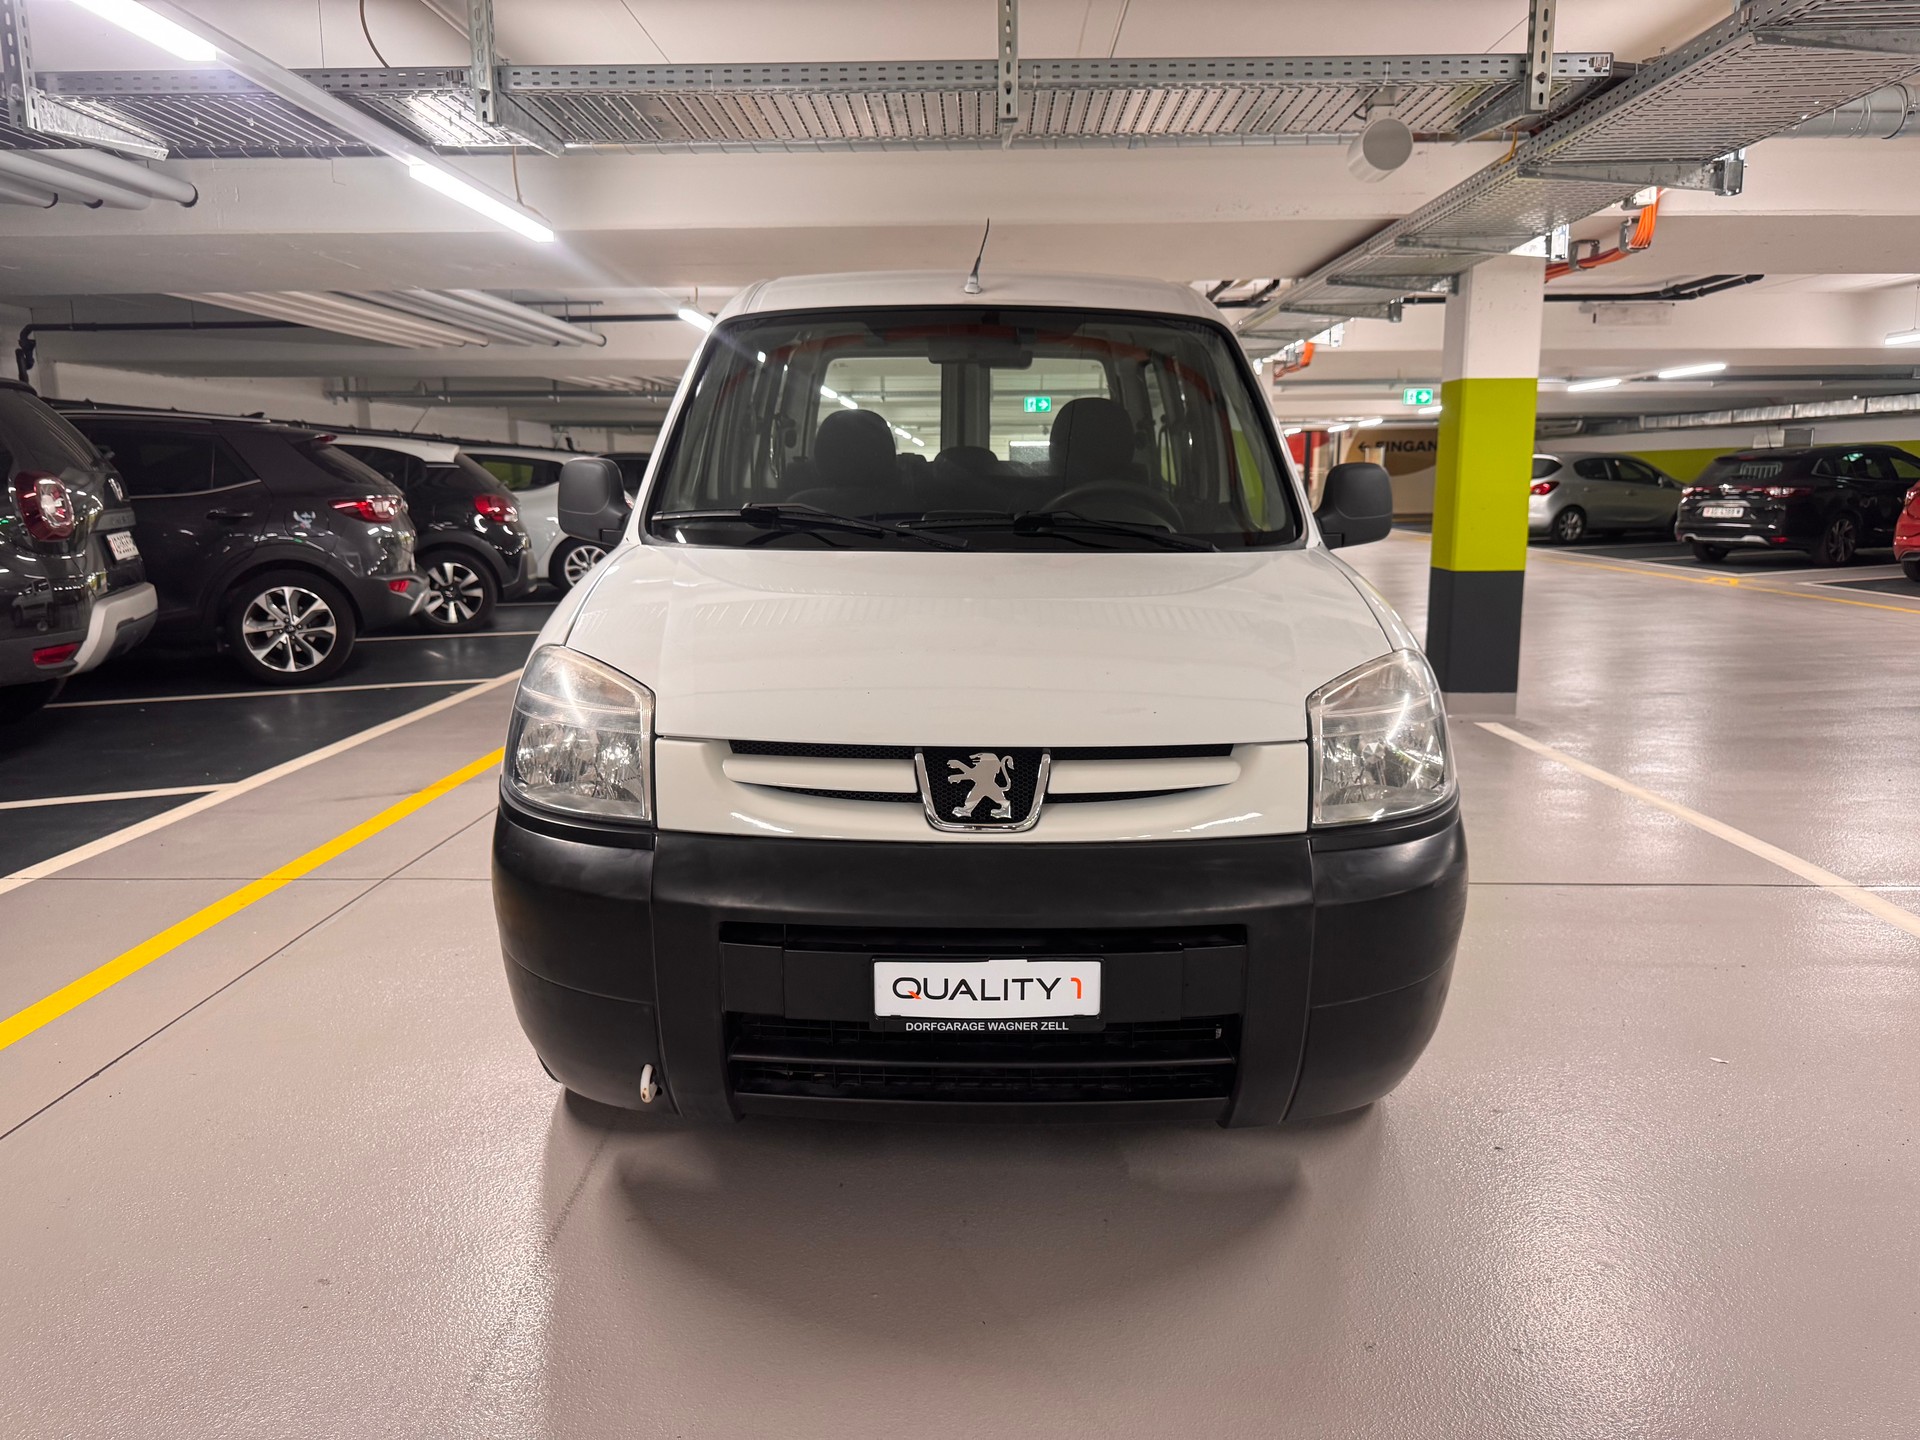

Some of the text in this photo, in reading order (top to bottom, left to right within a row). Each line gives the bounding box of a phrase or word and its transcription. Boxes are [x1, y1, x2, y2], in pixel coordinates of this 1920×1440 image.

[892, 977, 1082, 1001] QUALITY 1
[905, 1021, 1069, 1032] DORFGARAGE WAGNER ZELL
